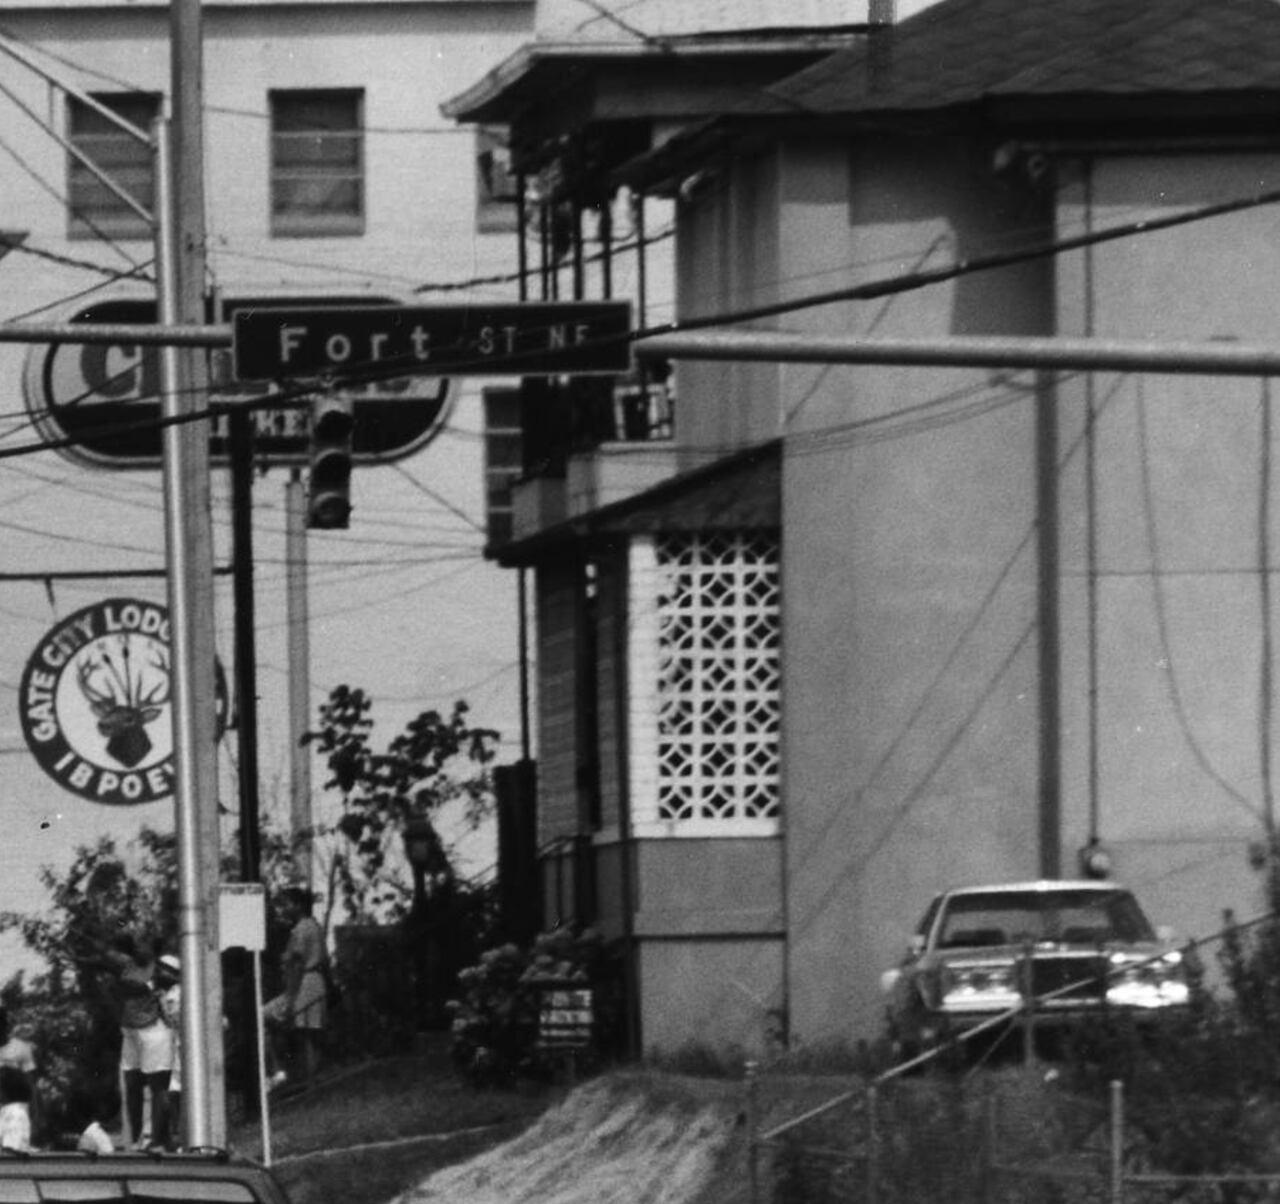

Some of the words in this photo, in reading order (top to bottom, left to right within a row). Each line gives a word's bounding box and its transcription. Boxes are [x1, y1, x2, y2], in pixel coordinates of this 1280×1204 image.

[279, 325, 430, 363] Fort
[478, 326, 517, 355] ST
[27, 668, 57, 742] GATE
[42, 613, 95, 668] CITY
